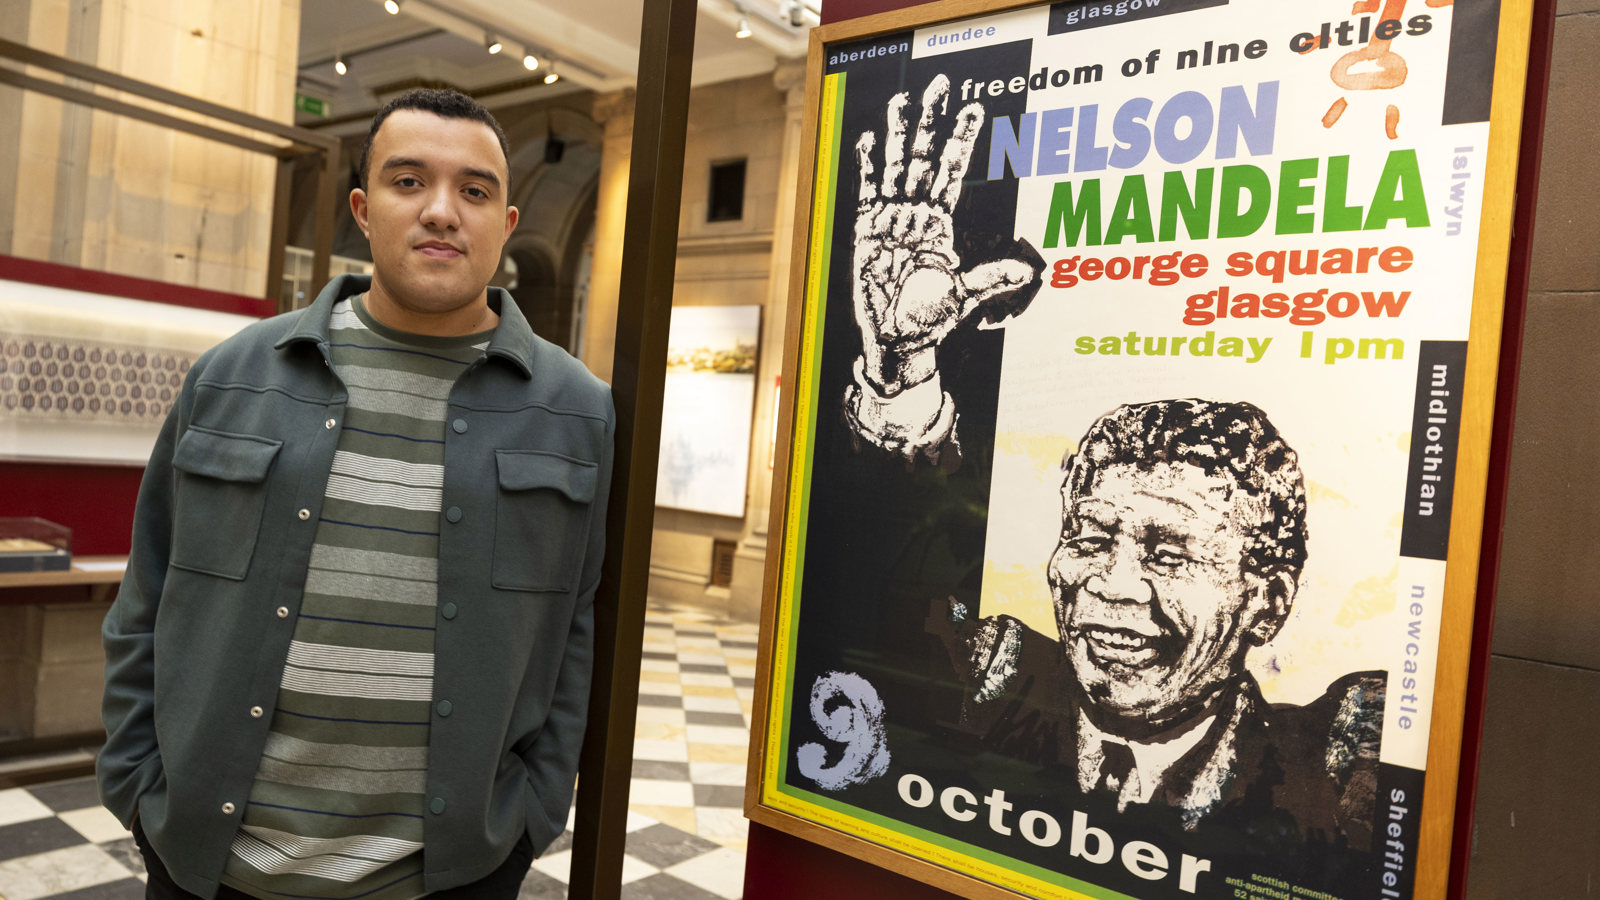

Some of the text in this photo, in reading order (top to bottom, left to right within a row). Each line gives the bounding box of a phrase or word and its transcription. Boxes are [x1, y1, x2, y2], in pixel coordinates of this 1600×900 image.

[1066, 0, 1160, 25] glasgow
[829, 42, 909, 66] aberdeen
[927, 26, 996, 48] dundee
[961, 14, 1432, 101] freedom of nine cities
[988, 80, 1279, 181] NELSON
[1042, 149, 1431, 248] MANDELA
[1050, 245, 1414, 288] george square
[1183, 286, 1411, 326] glasgow
[1074, 331, 1273, 363] saturday
[1418, 364, 1450, 516] midlothian
[1398, 585, 1425, 730] newcastle
[797, 671, 891, 791] 9
[898, 774, 1211, 893] october
[1381, 788, 1408, 900] sheffiel
[1225, 876, 1290, 900] anti-apartheid
[1234, 888, 1248, 899] 52
[1251, 873, 1290, 890] scottish
